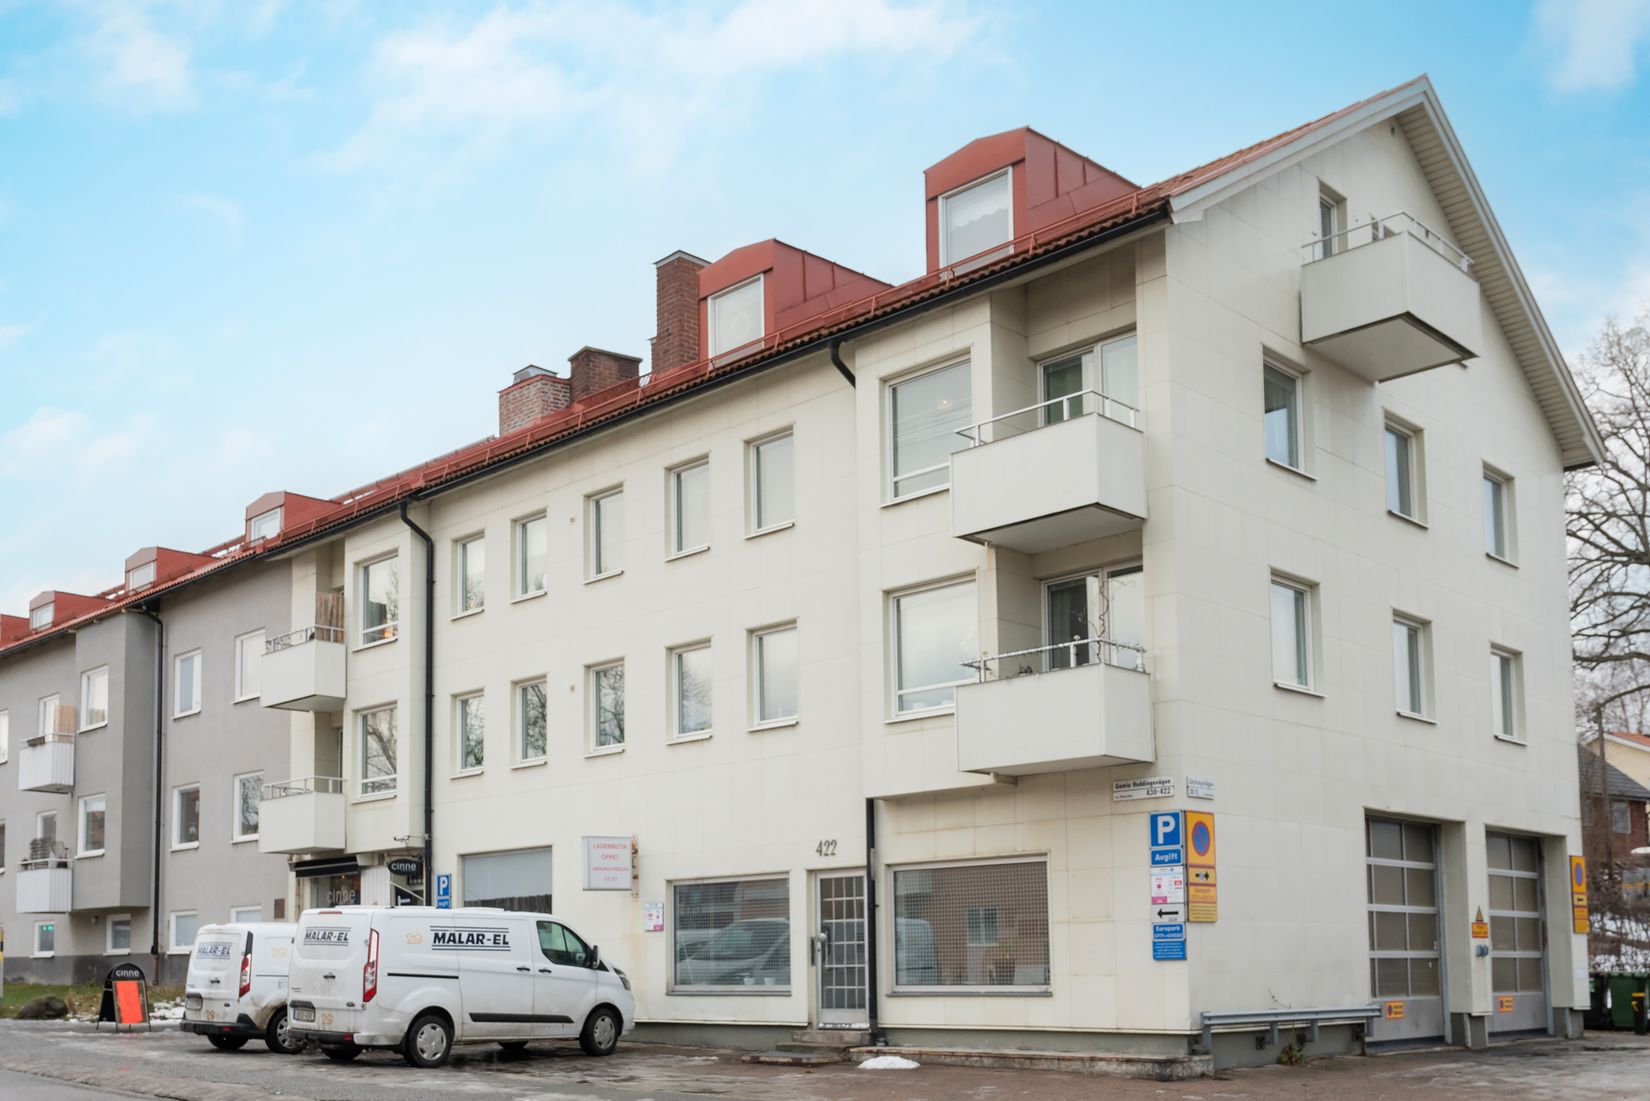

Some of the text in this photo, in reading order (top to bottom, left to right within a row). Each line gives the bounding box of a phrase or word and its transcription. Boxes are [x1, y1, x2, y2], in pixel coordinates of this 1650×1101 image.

[1157, 815, 1175, 844] P
[815, 839, 837, 856] 422
[1154, 853, 1178, 862] Avgift
[391, 862, 417, 871] cinne
[439, 876, 448, 896] P
[327, 888, 356, 904] cinne
